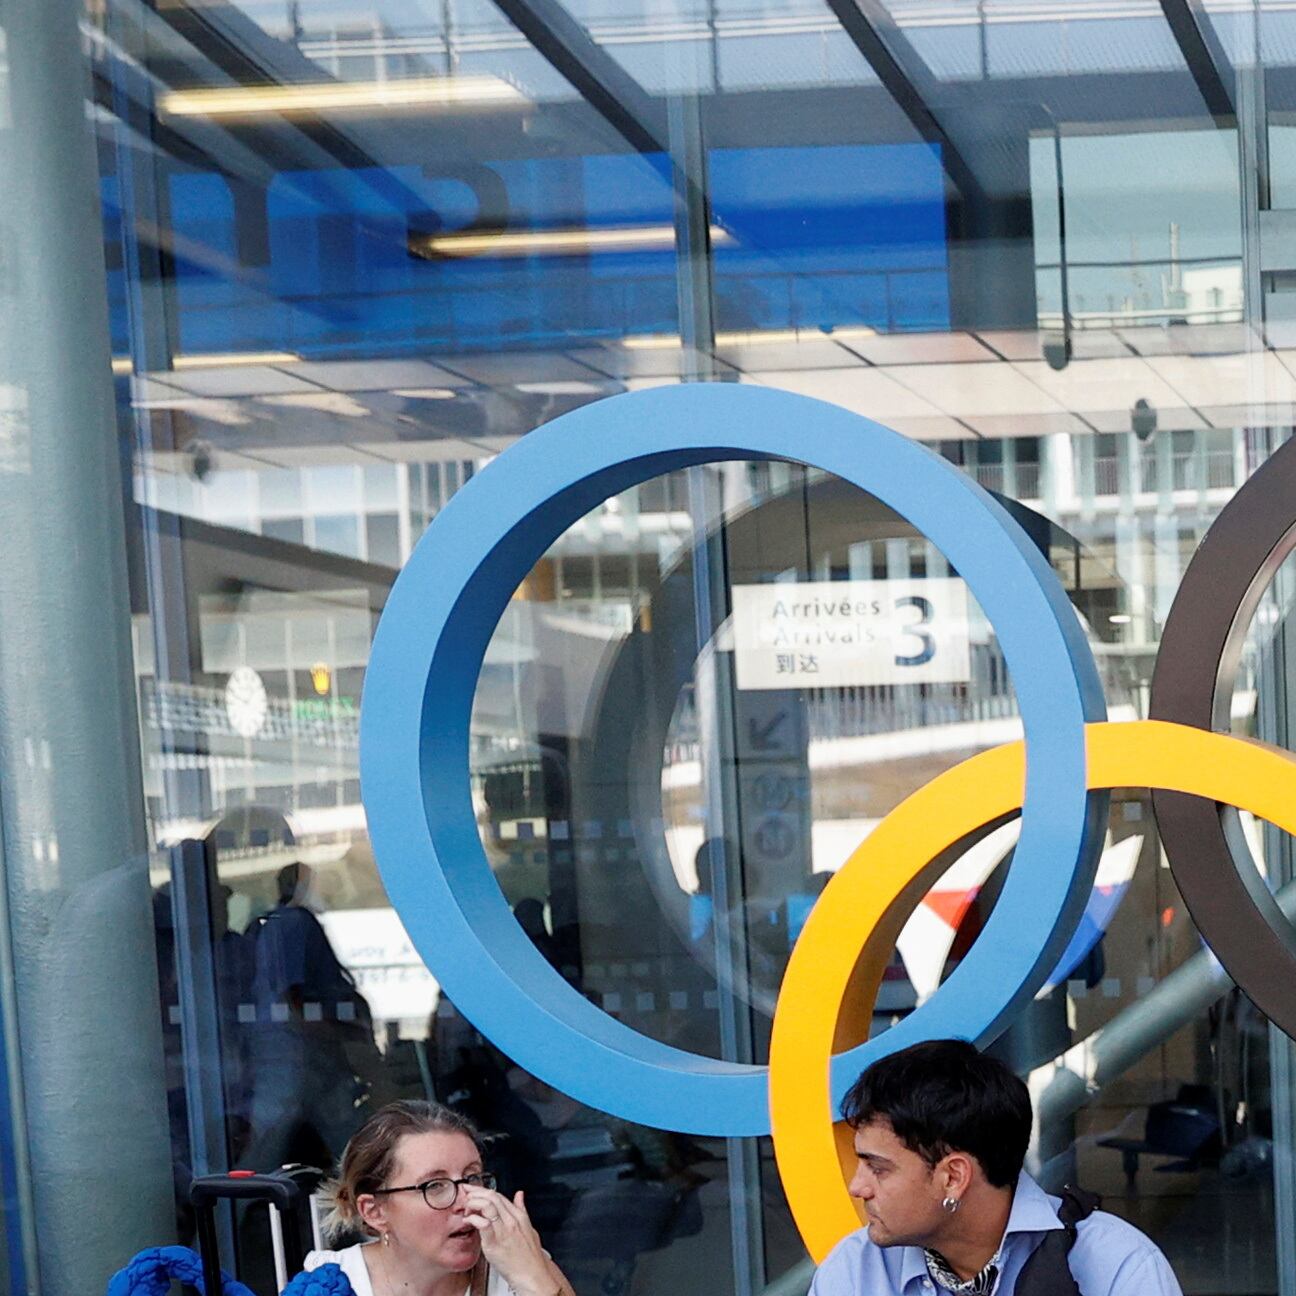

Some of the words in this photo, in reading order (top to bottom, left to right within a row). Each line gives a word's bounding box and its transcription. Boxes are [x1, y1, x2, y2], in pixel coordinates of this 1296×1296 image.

[772, 597, 881, 619] Arrivées
[774, 622, 876, 646] Arrivals
[894, 595, 937, 667] 3
[776, 653, 820, 675] 到达
